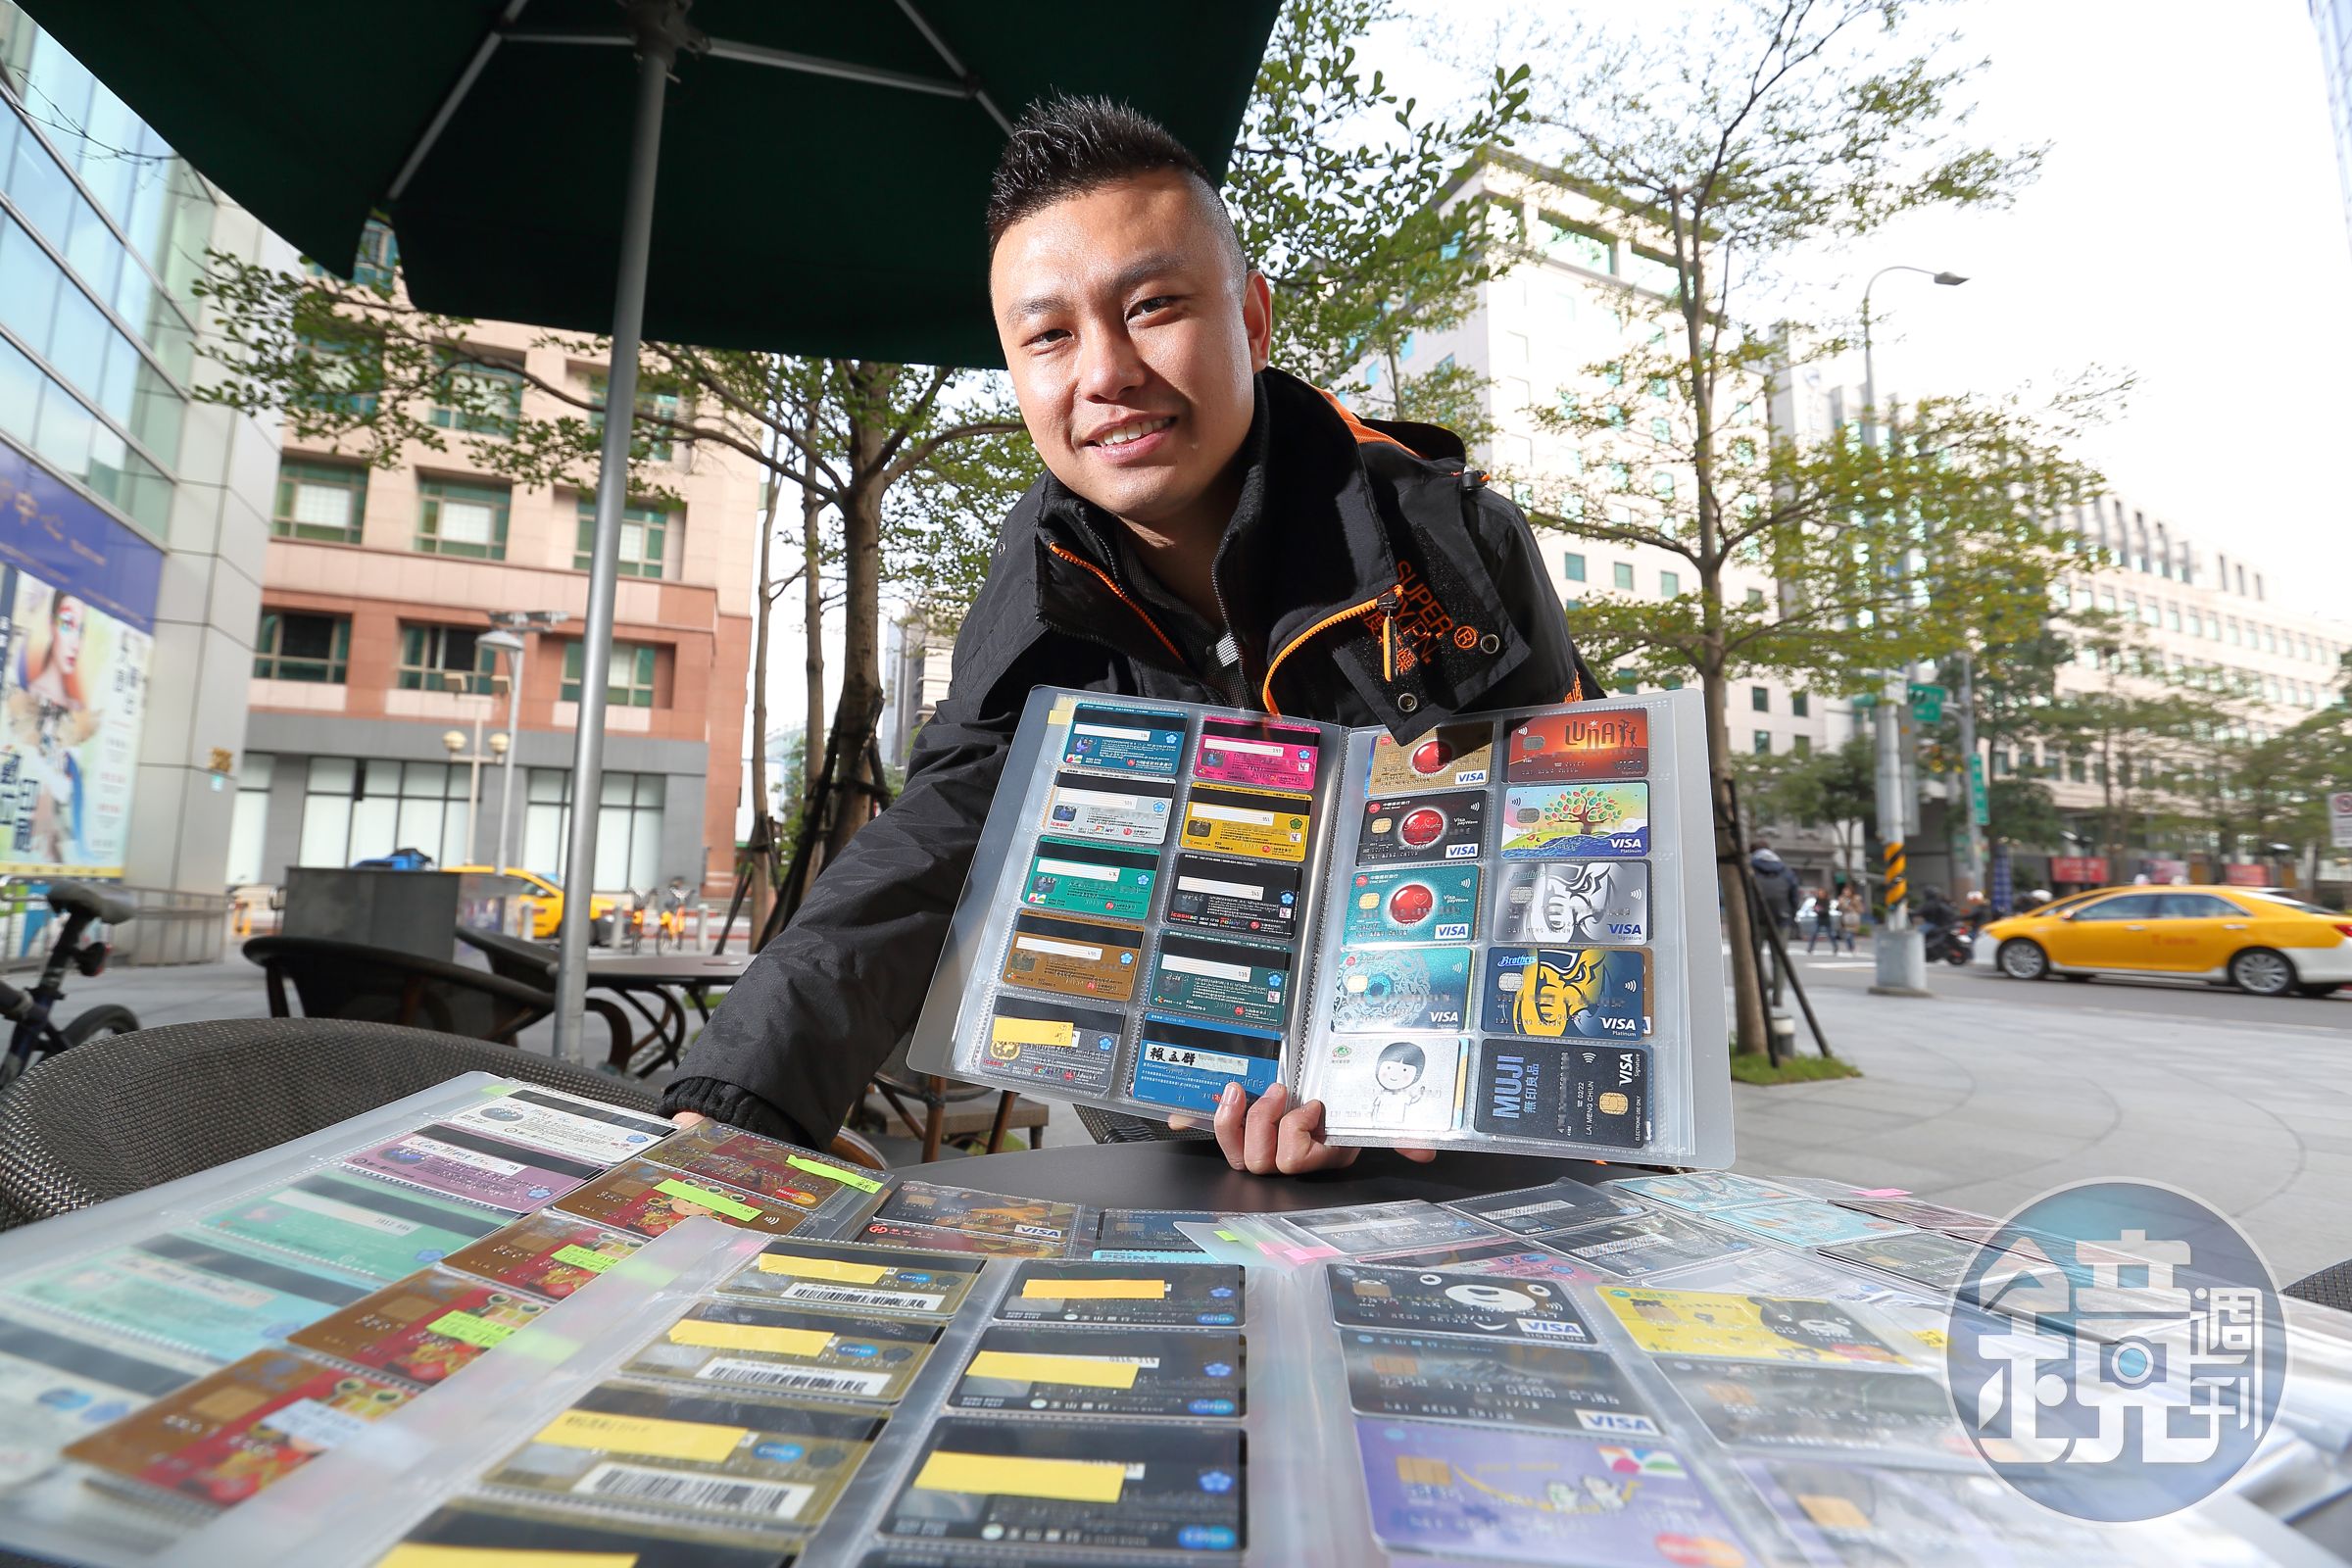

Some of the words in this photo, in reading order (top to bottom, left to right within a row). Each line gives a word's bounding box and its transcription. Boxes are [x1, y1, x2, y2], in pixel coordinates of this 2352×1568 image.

[1397, 560, 1454, 638] SUPER
[1458, 773, 1484, 782] VISA
[1610, 839, 1642, 848] VISA
[1449, 846, 1475, 856] VISA
[1439, 926, 1466, 937] VISA
[1607, 924, 1642, 935] VISA
[1497, 955, 1537, 967] Brothers
[1429, 1011, 1458, 1022] VISA
[1599, 1017, 1636, 1030] VISA
[1619, 1054, 1633, 1087] VISA
[1493, 1055, 1524, 1119] MUJI
[1523, 1063, 1540, 1113] 無印良品
[1020, 1227, 1059, 1238] VISA
[1526, 1321, 1580, 1334] VISA
[1584, 1414, 1654, 1432] VISA
